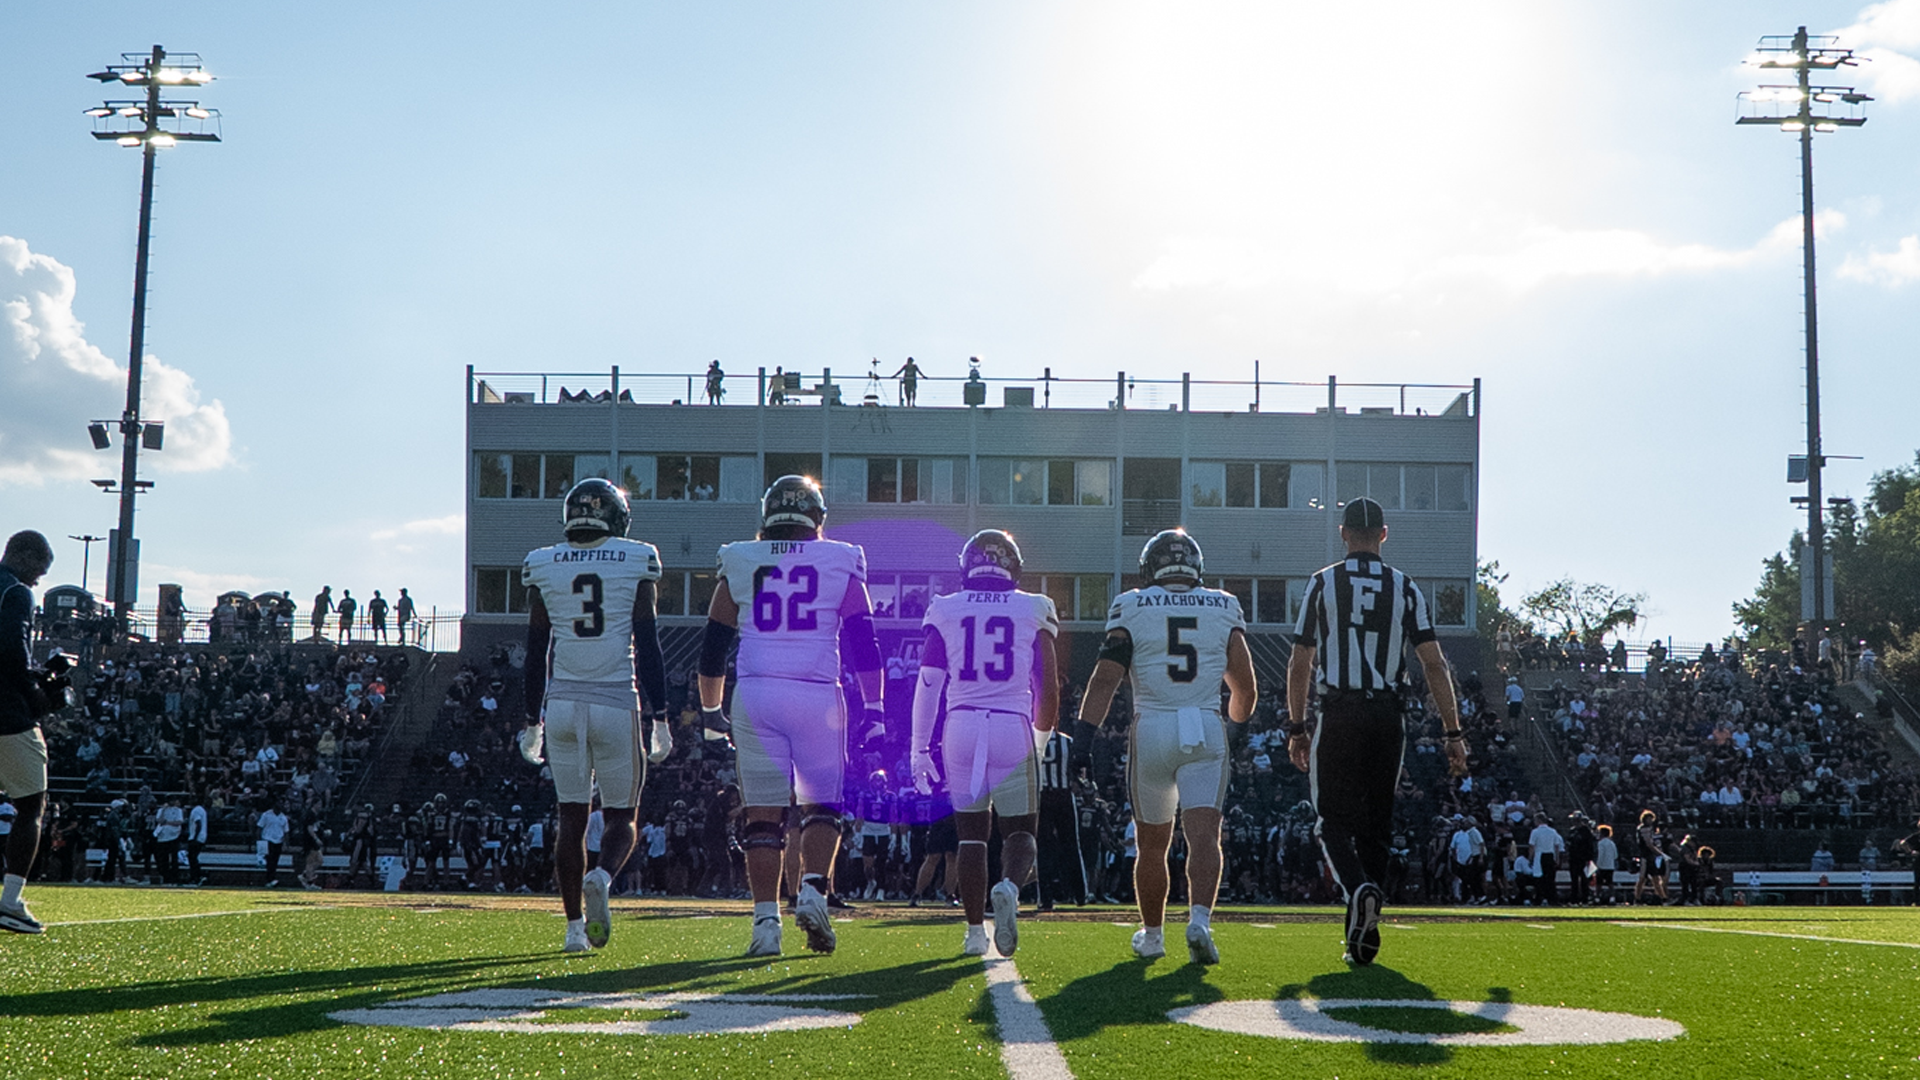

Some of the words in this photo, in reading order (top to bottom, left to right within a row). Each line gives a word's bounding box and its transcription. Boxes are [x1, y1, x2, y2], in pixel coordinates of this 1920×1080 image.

[553, 550, 627, 563] CAMPFIELD
[770, 541, 806, 555] HUNT
[572, 573, 604, 638] 3
[753, 565, 819, 633] 62
[967, 593, 1011, 605] PERRY
[1136, 594, 1230, 610] ZAYACHOWSKY
[1349, 576, 1383, 626] F
[959, 615, 1016, 682] 13
[1166, 616, 1198, 683] 5
